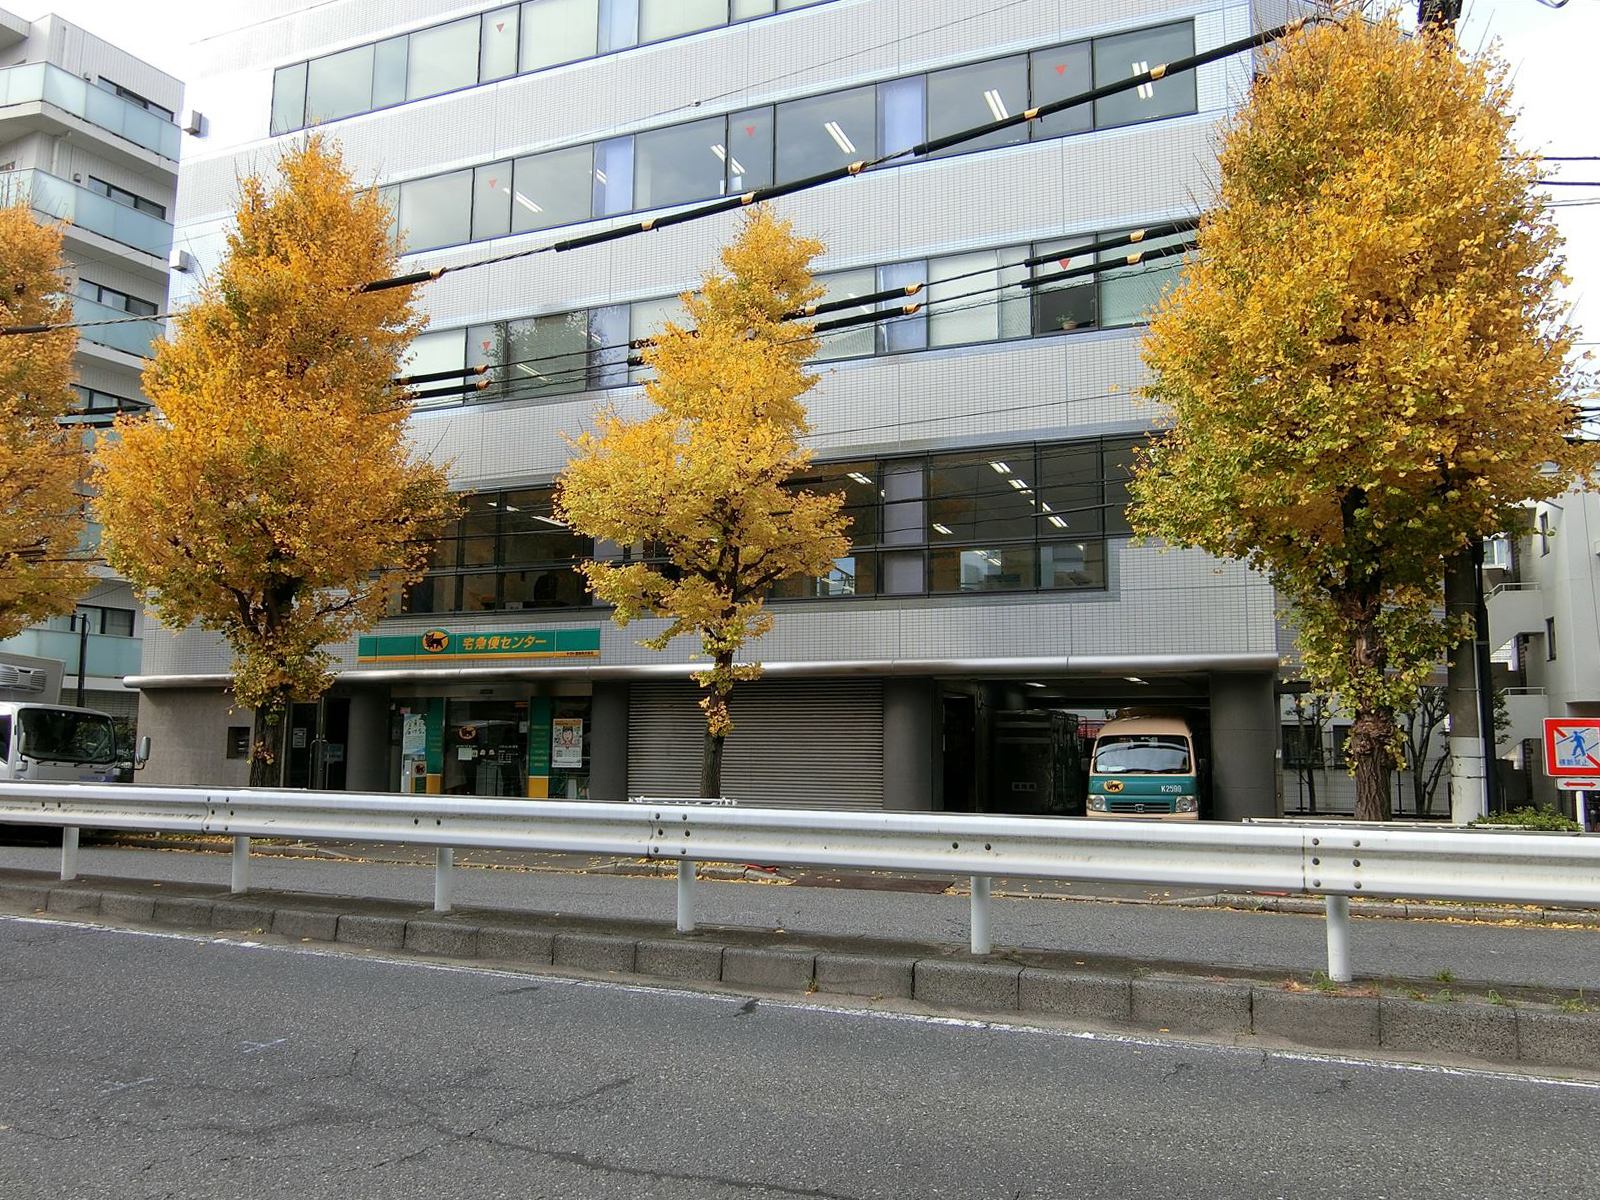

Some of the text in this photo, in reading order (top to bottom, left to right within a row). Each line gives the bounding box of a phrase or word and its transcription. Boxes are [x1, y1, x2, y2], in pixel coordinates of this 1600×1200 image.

[462, 635, 547, 651] 宅急便センター
